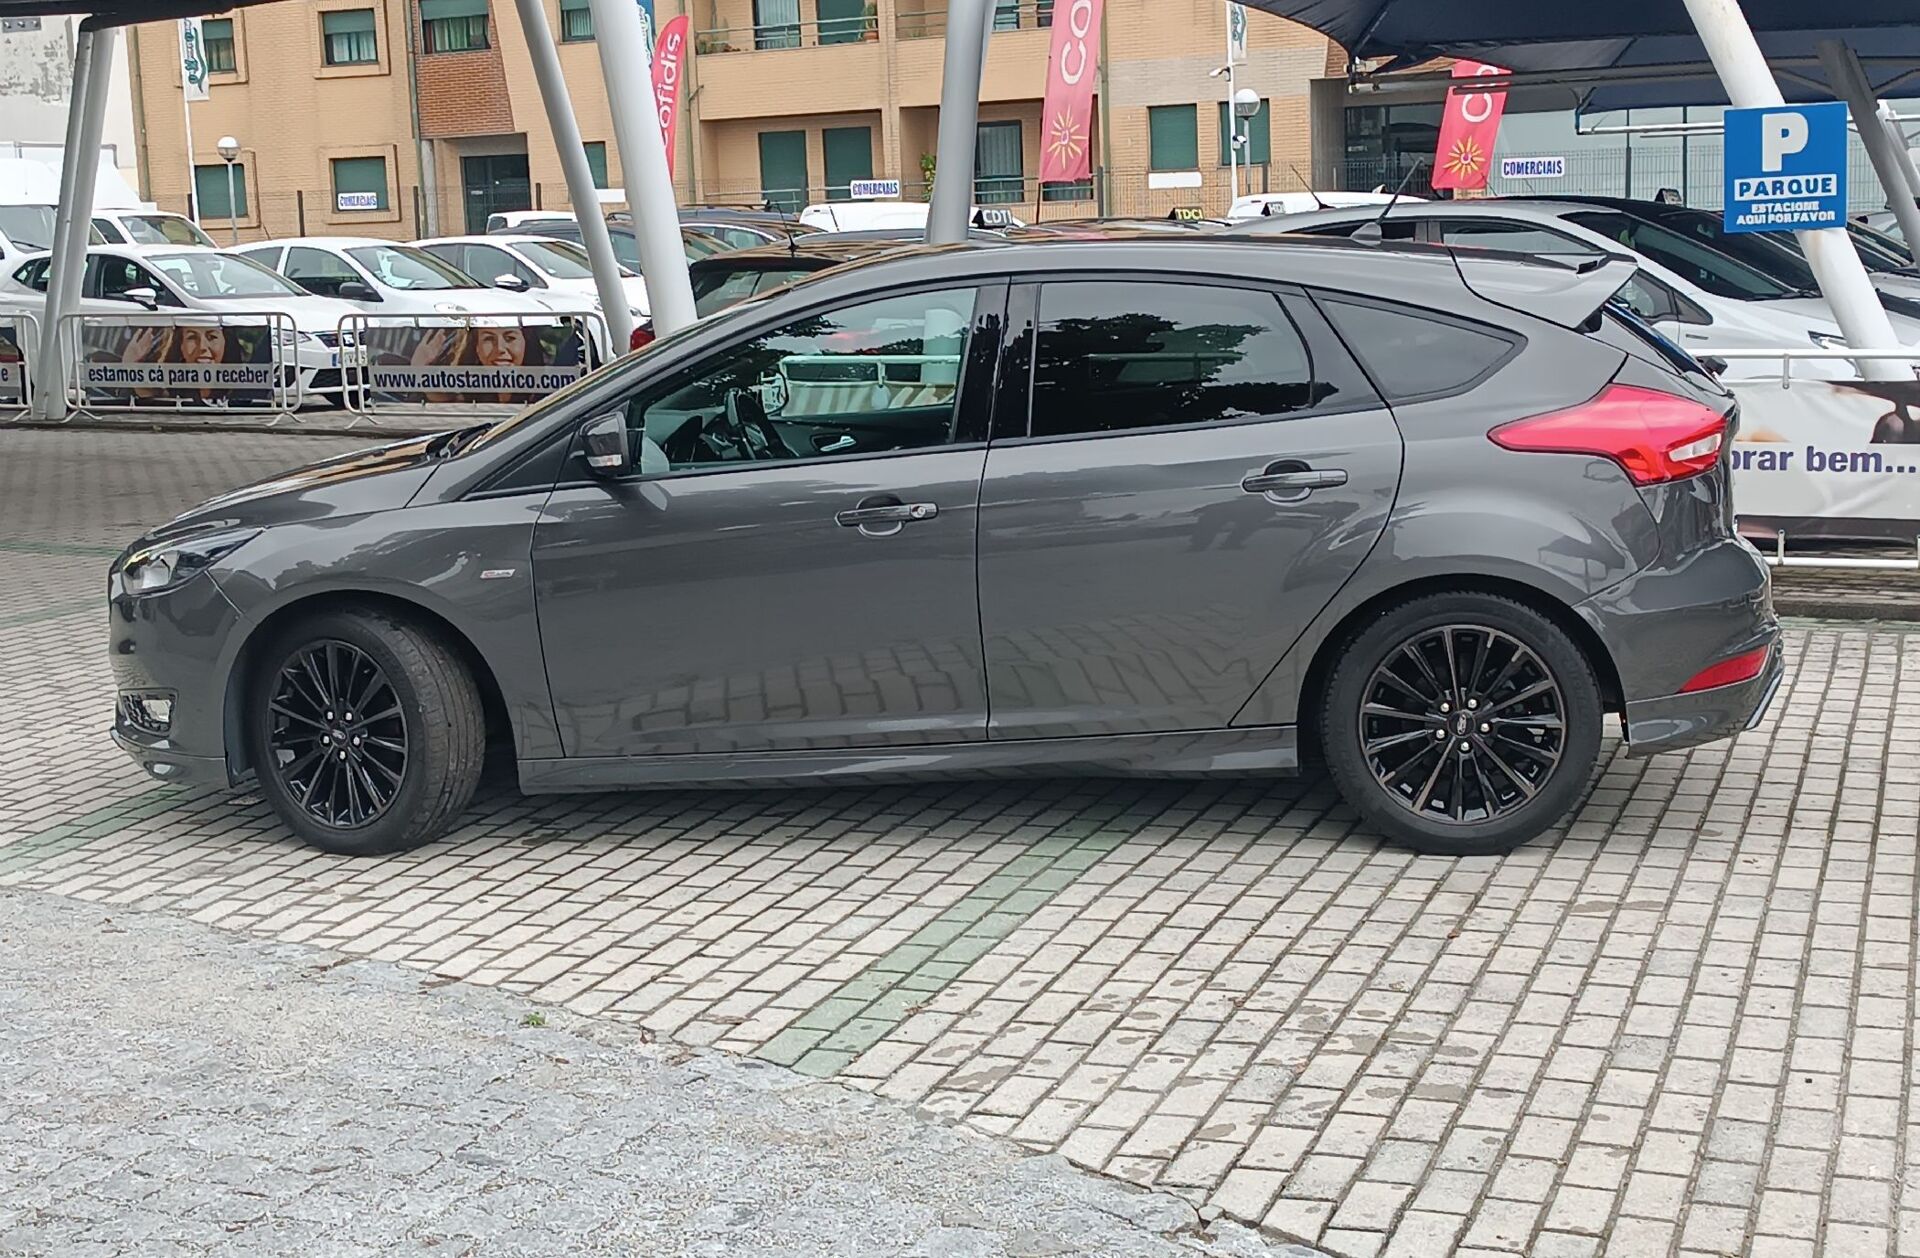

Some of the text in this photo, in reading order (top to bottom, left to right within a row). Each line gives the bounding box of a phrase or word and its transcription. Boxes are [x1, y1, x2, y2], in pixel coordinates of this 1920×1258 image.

[1762, 112, 1809, 172] P
[1503, 160, 1563, 176] COMERCIAIS
[1739, 177, 1832, 197] PARQUE
[983, 209, 1013, 224] CDTI
[1175, 208, 1203, 220] TDCI
[1736, 214, 1766, 225] AQUI
[88, 365, 269, 385] estamos cá para o receber
[374, 370, 576, 389] www.autostandxico.com
[1806, 445, 1916, 474] bem...
